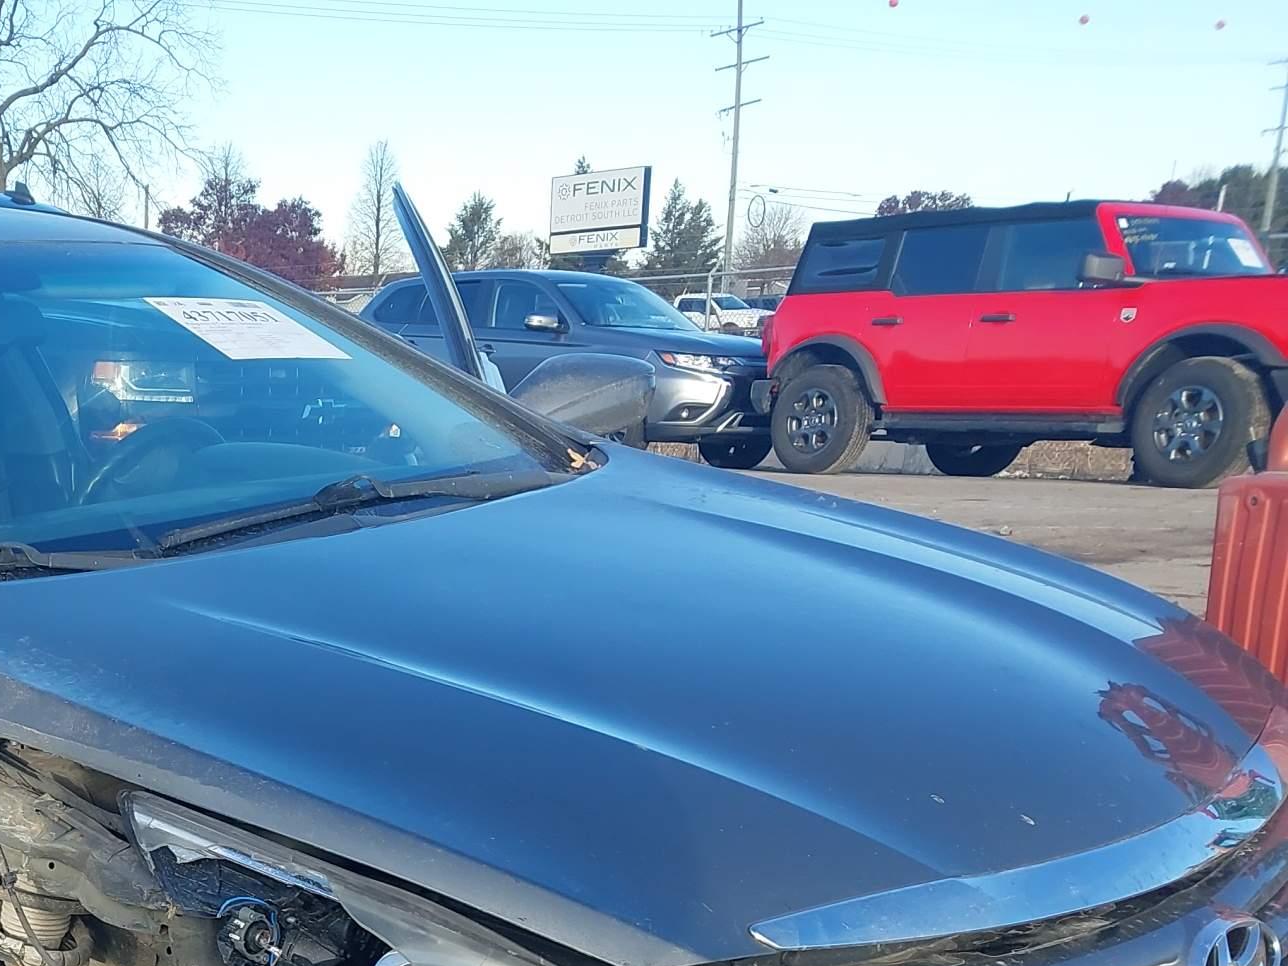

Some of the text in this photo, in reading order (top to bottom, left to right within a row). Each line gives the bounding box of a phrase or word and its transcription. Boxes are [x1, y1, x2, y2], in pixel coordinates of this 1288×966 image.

[573, 176, 637, 197] FENIX
[584, 198, 639, 211] FENIX PARTS
[554, 213, 589, 224] DETROIT
[592, 209, 620, 220] SOUTH
[578, 232, 618, 244] FENIX
